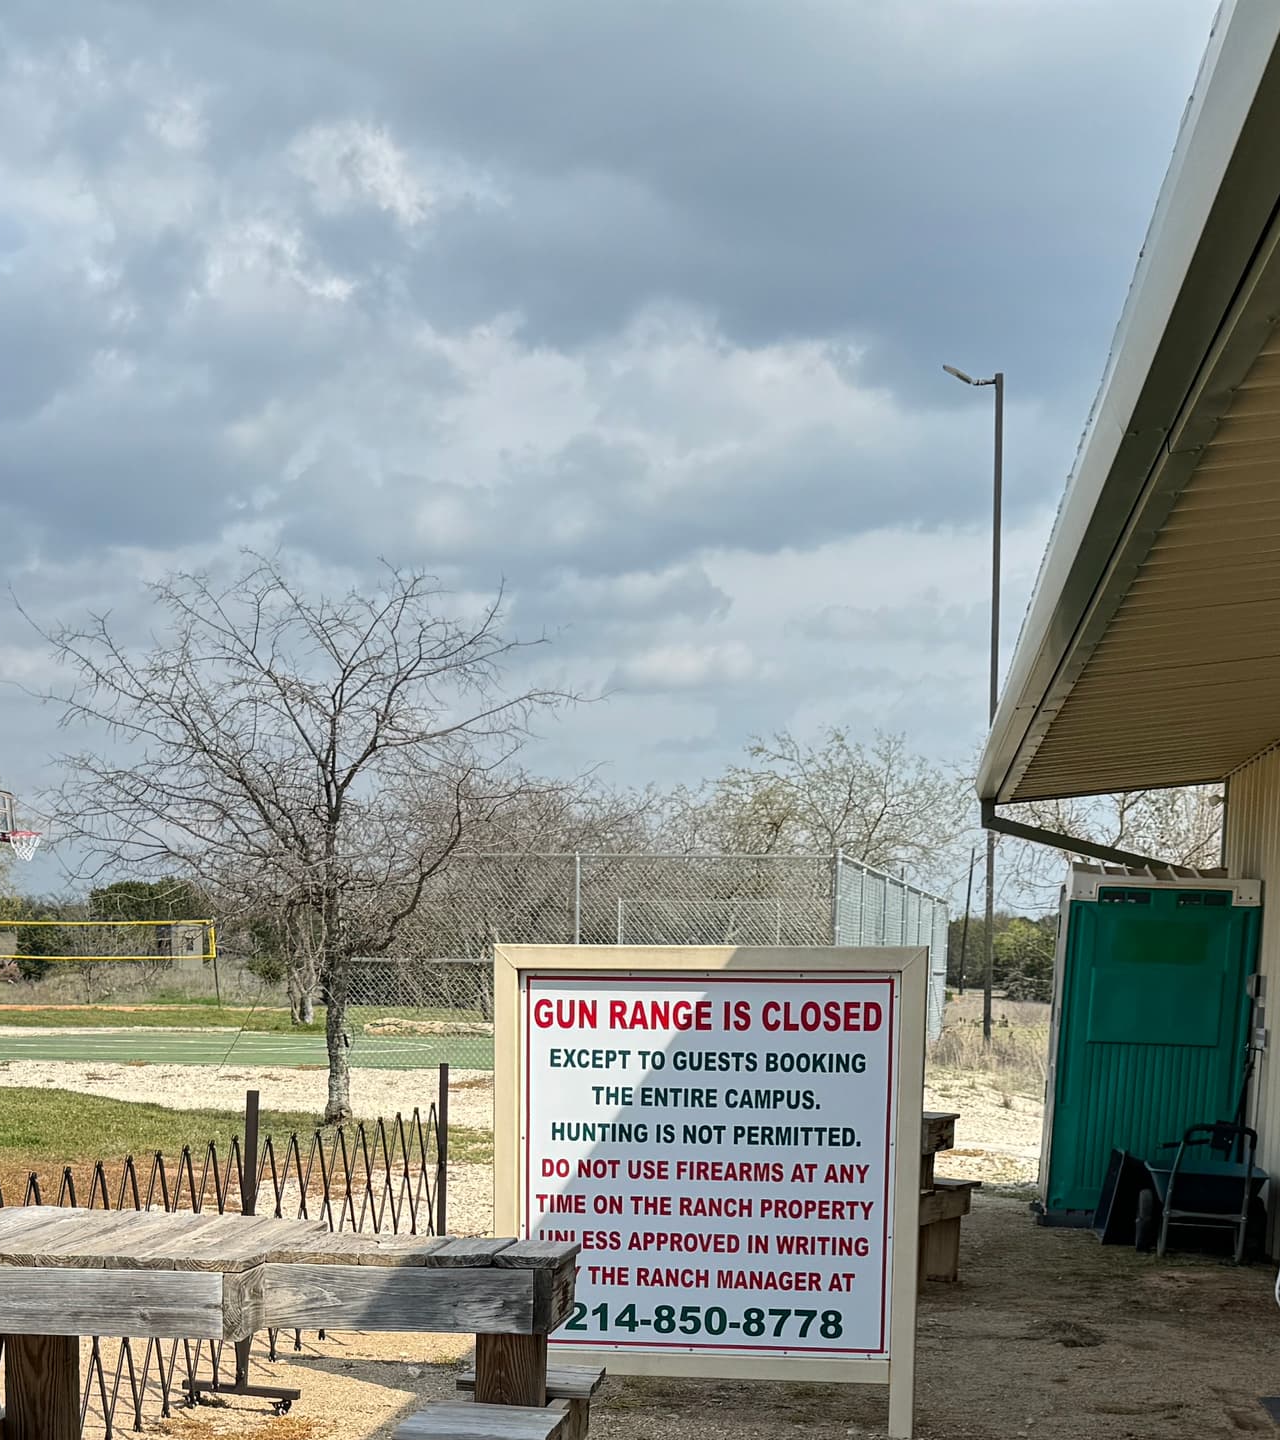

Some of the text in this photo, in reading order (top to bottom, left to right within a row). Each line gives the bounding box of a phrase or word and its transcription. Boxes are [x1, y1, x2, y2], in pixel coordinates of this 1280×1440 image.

[534, 999, 882, 1031] GUN RANGE IS CLOSED
[550, 1049, 866, 1073] EXCEPT TO GUESTS BOOKING
[592, 1087, 820, 1110] THE ENTIRE CAMPUS.
[552, 1122, 861, 1147] HUNTING IS NOT PERMITTED.
[542, 1159, 870, 1183] DO NOT USE FIREARMS AT ANY
[536, 1194, 874, 1220] TIME ON THE RANCH PROPERTY
[628, 1232, 739, 1253] APPROVED
[748, 1235, 768, 1254] IN
[776, 1235, 869, 1256] WRITING
[588, 1266, 629, 1286] THE
[637, 1268, 709, 1288] RANCH
[717, 1270, 821, 1291] MANAGER
[828, 1273, 855, 1292] AT
[564, 1302, 844, 1340] 214-850-8778
